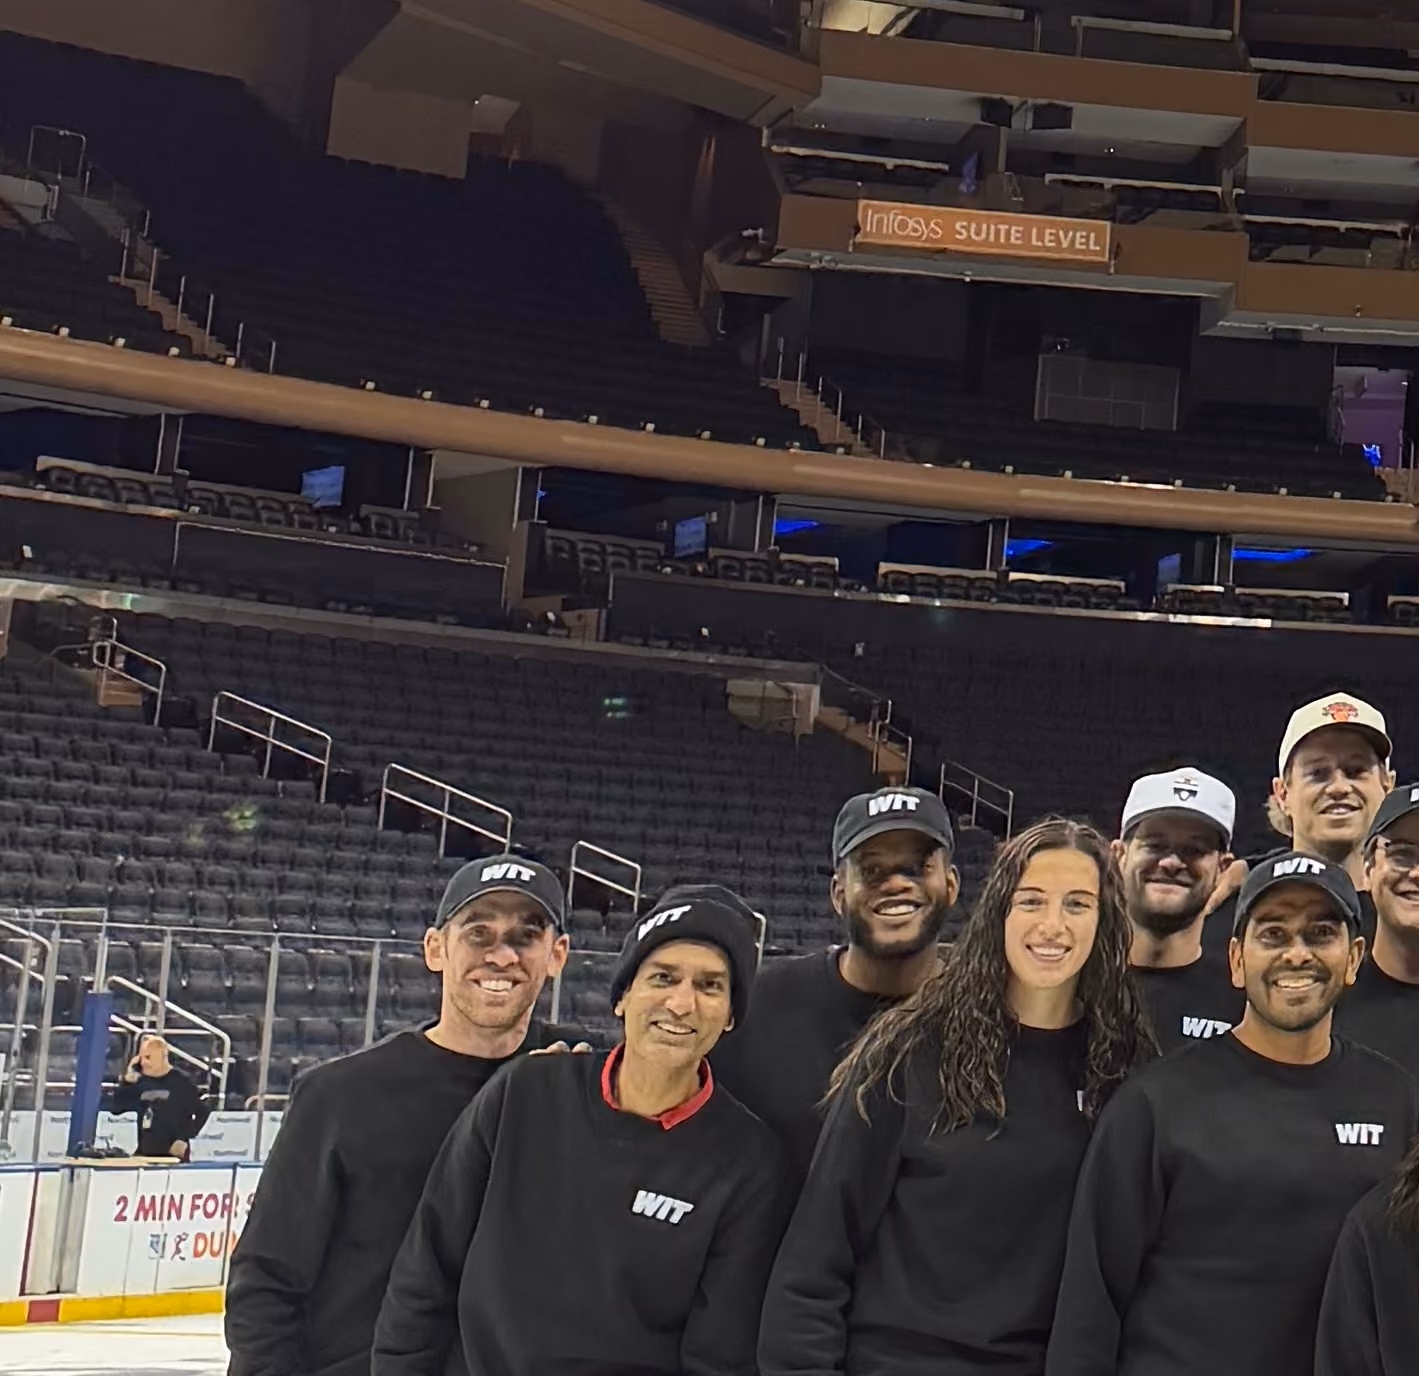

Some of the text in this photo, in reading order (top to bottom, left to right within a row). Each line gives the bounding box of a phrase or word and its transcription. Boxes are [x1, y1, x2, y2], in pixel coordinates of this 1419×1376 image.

[866, 208, 1101, 251] Infosys SUITE LEVEL
[869, 794, 921, 816] WIT
[481, 863, 537, 882] WIT
[1274, 857, 1327, 877] WIT
[638, 904, 692, 941] WIT
[1183, 1016, 1231, 1038] WIT
[1336, 1123, 1384, 1145] WIT
[113, 1194, 129, 1222] 2
[133, 1193, 184, 1222] MIN
[189, 1193, 240, 1220] FOR
[633, 1190, 694, 1224] WIT
